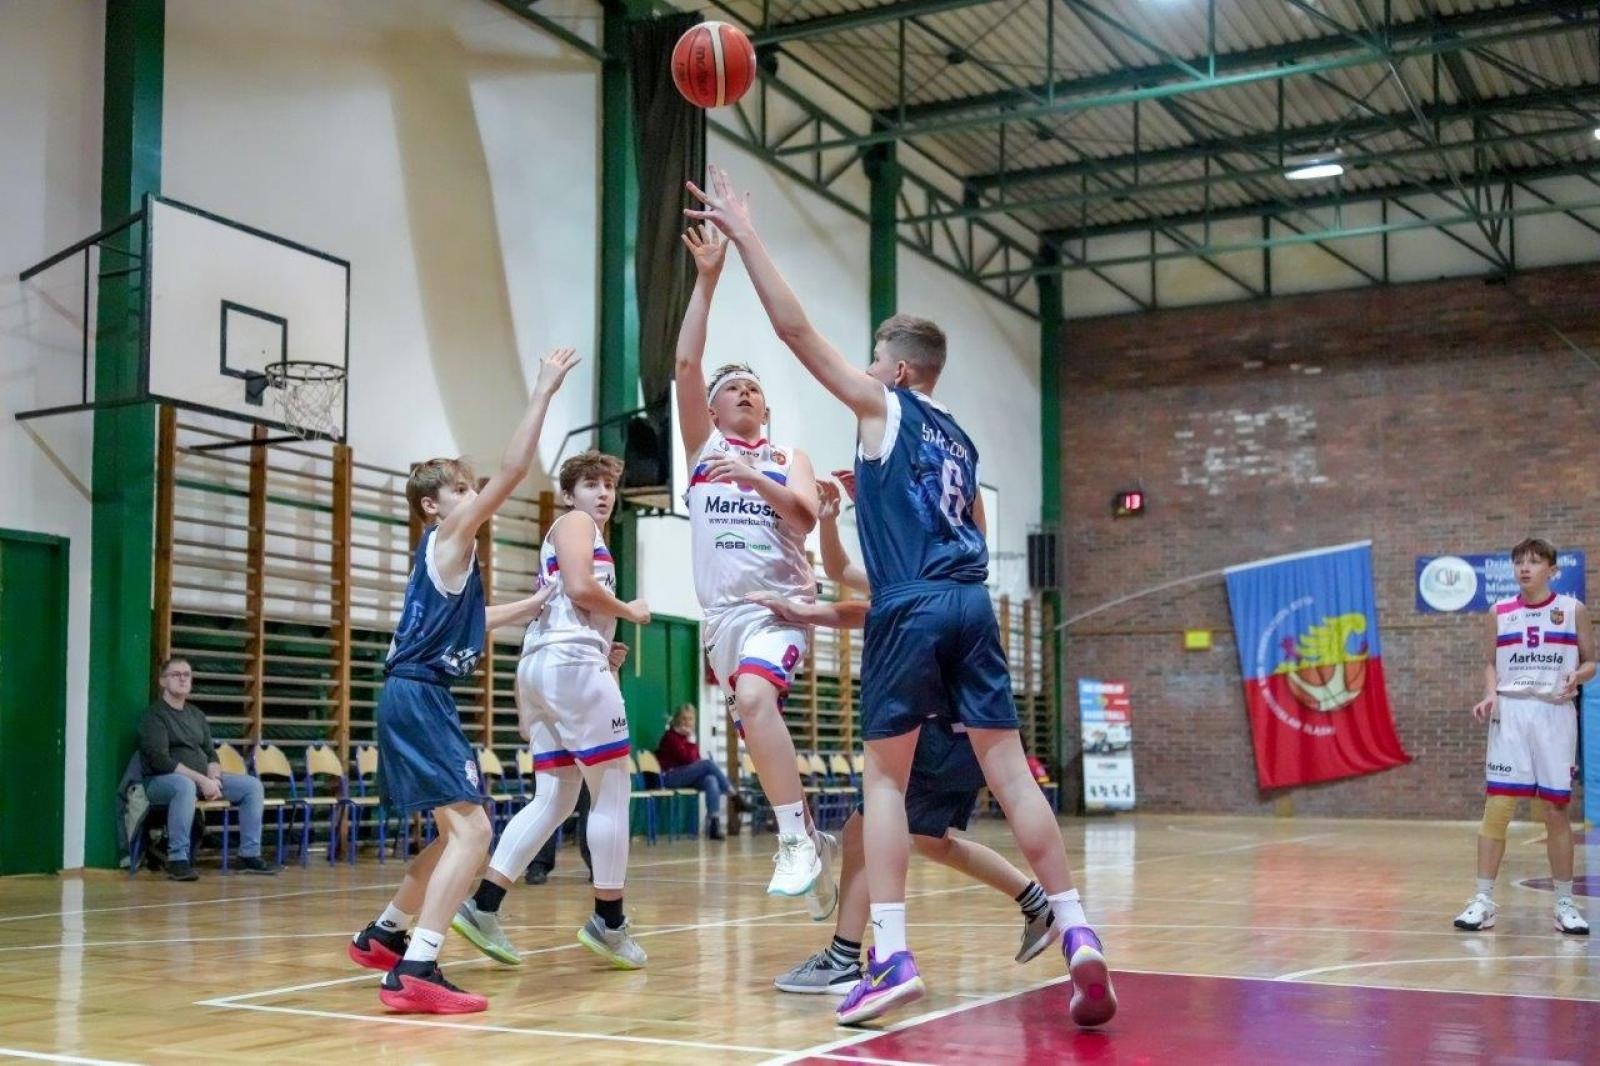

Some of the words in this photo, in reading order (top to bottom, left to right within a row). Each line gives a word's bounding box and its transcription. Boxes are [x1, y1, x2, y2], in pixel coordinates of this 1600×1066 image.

[940, 458, 966, 527] 6
[715, 541, 746, 550] ASB
[1527, 626, 1541, 649] 5
[781, 644, 800, 672] 8
